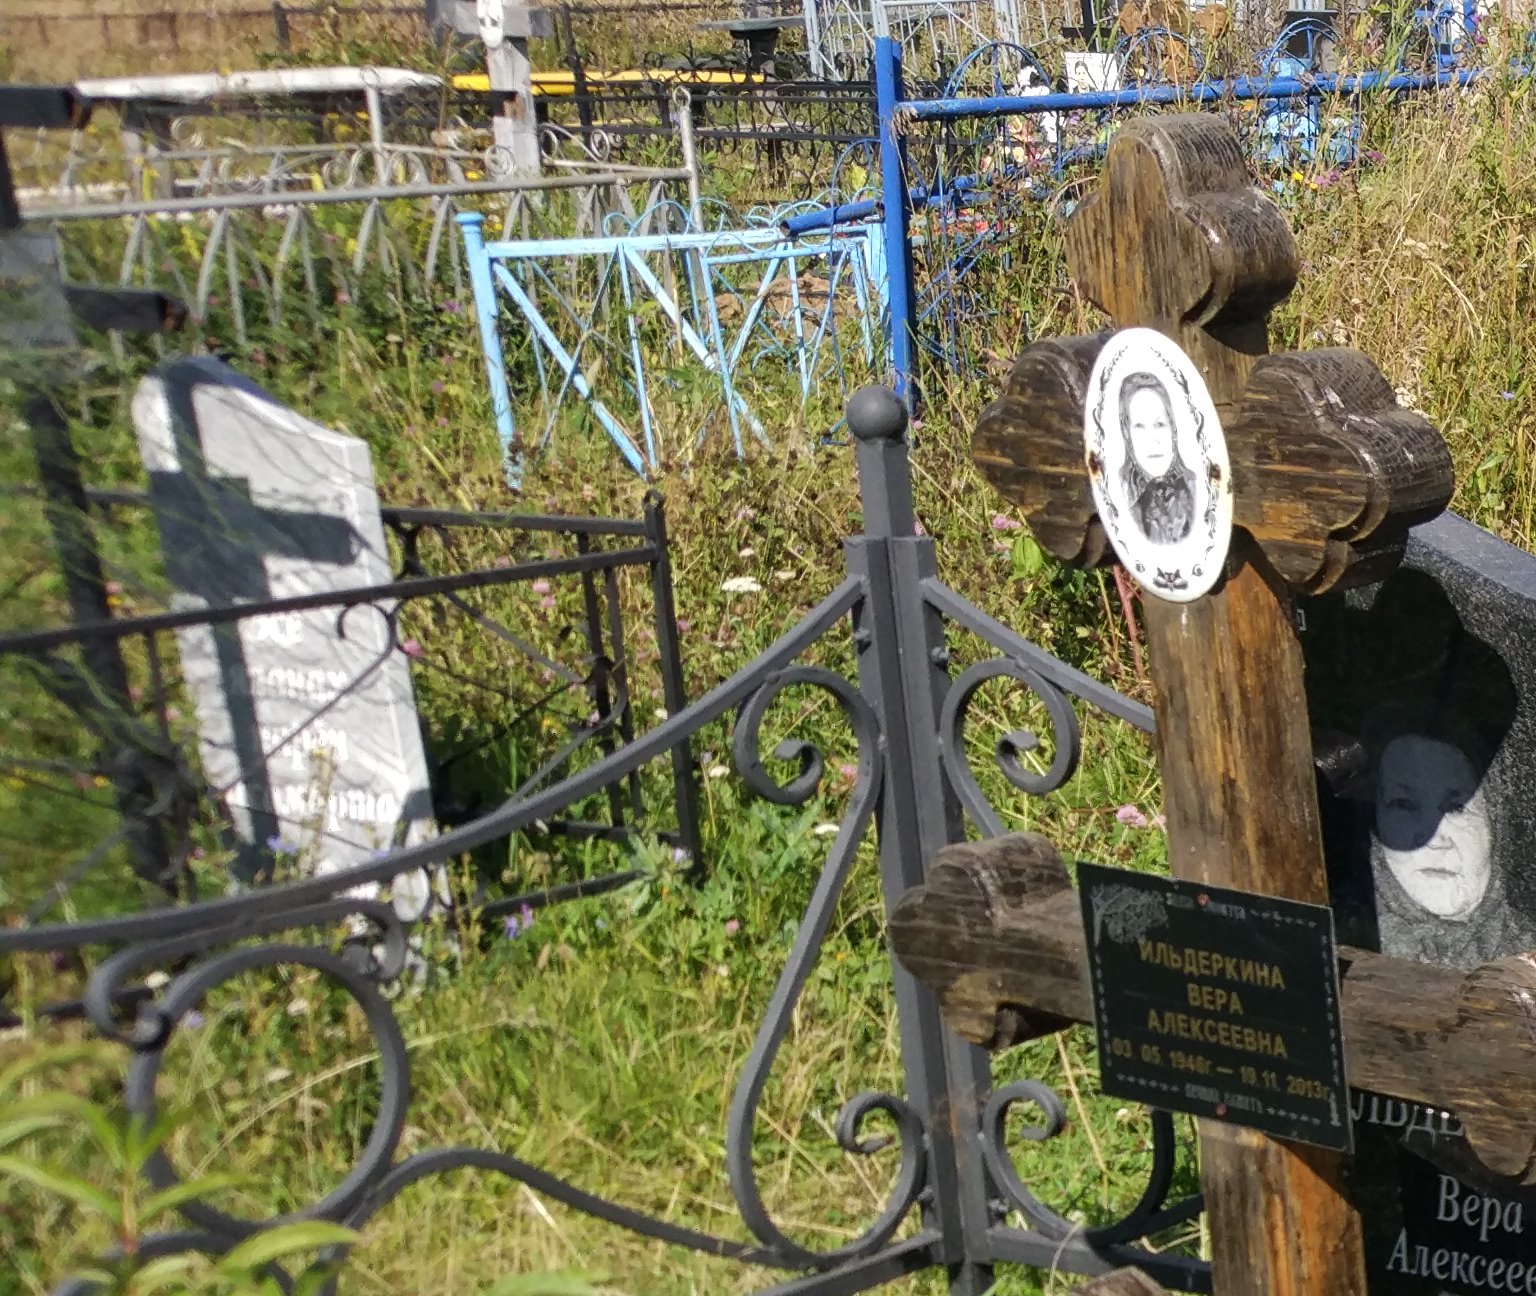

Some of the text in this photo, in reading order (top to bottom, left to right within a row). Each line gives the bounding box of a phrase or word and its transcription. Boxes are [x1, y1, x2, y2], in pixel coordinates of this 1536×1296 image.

[1137, 935, 1287, 991] ИЛЬДЕРКИНА
[1186, 983, 1244, 1016] ВЕРА
[1147, 1009, 1288, 1060] АЛЕКСЕЕВНА
[1436, 1173, 1525, 1243] Вера
